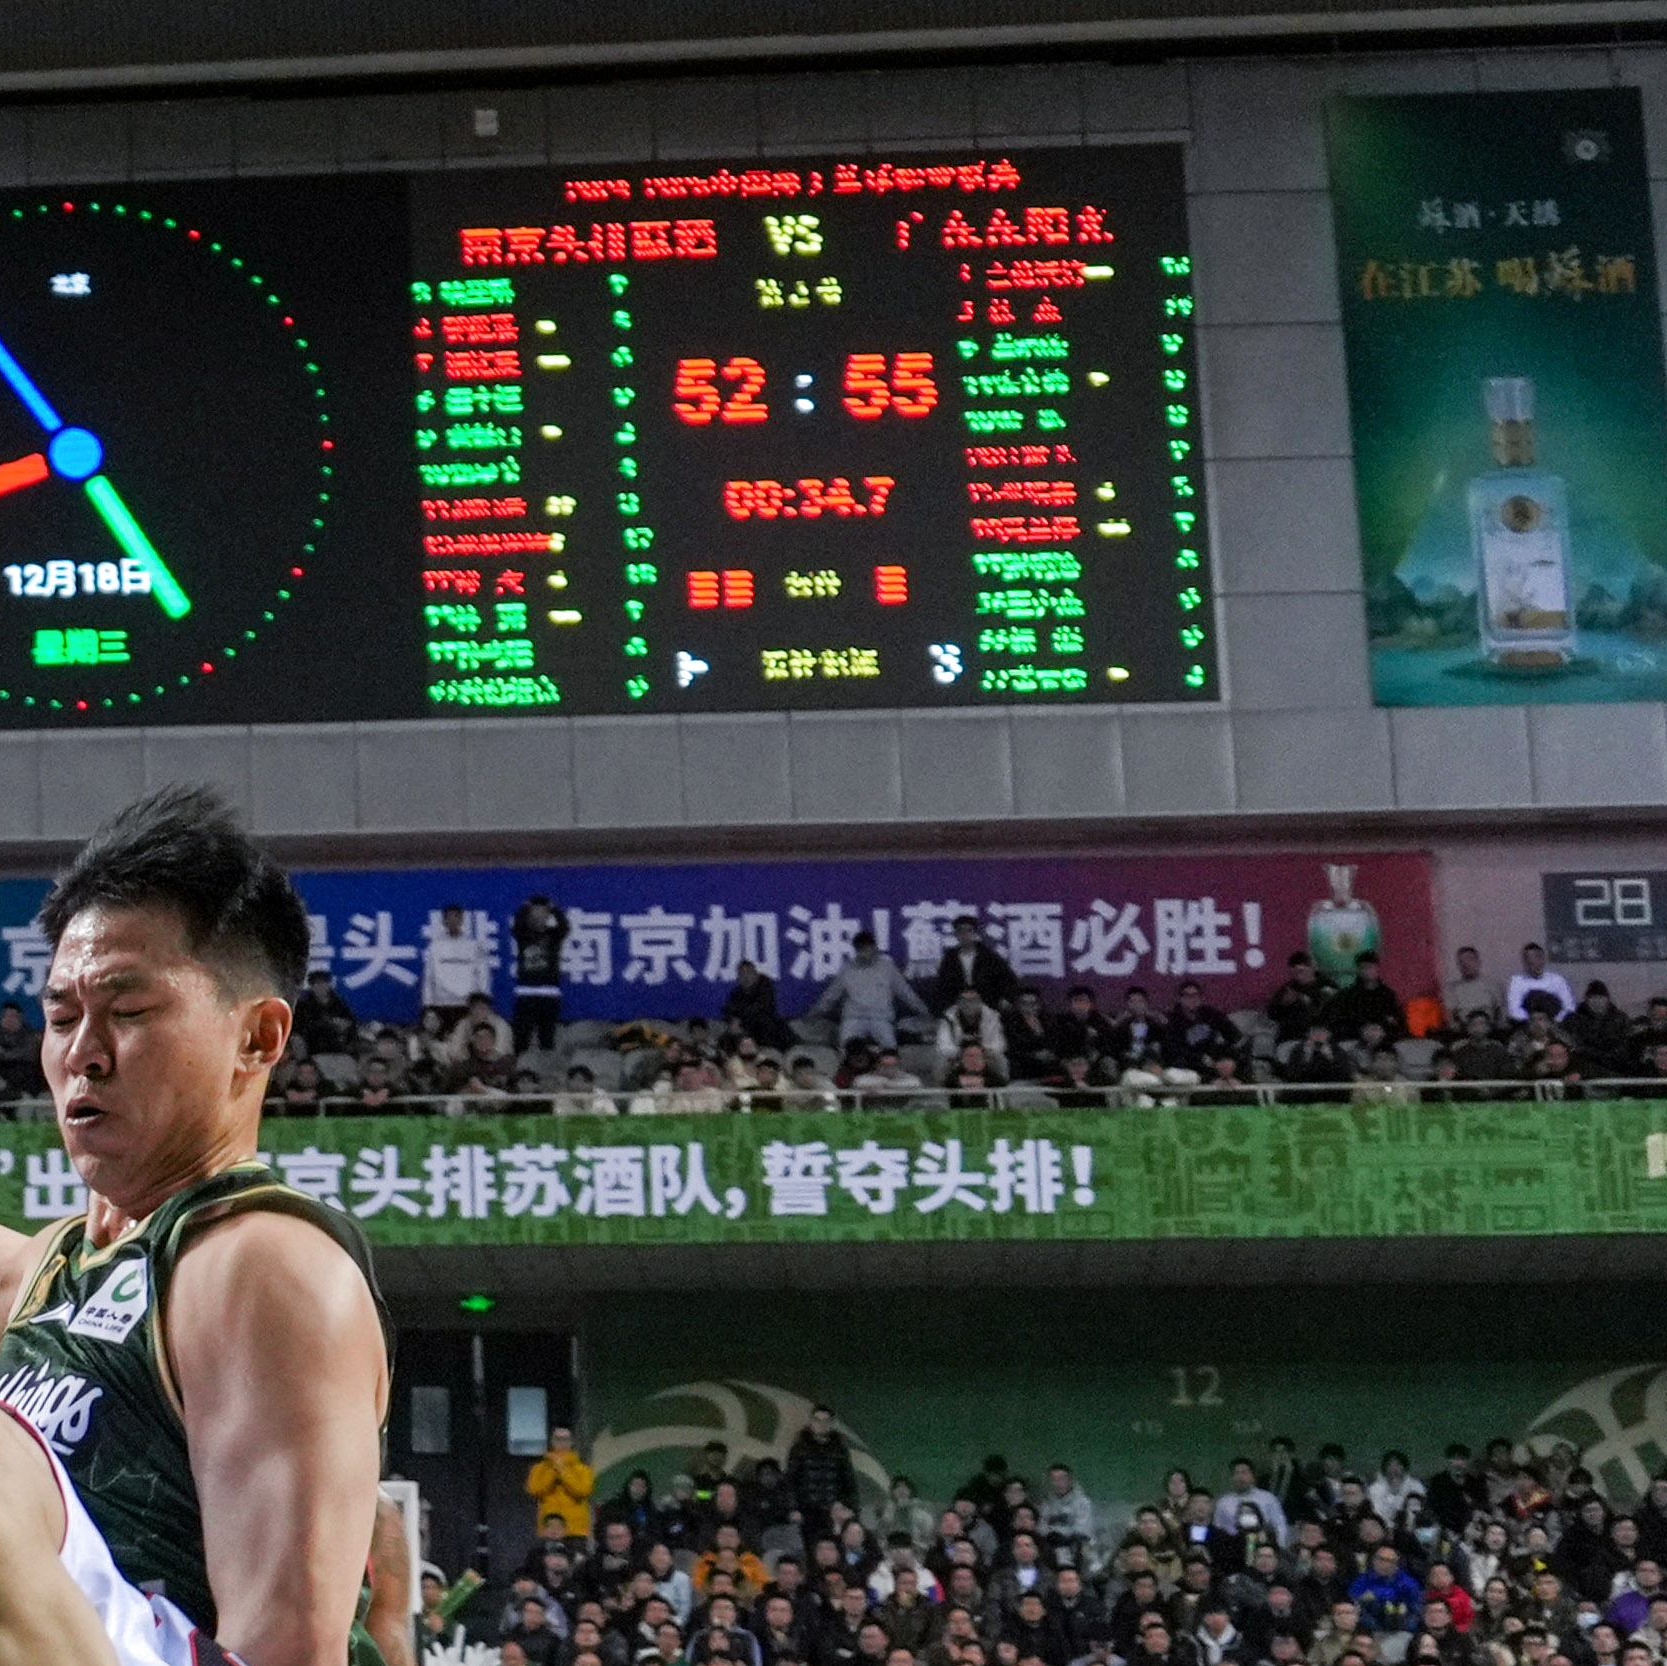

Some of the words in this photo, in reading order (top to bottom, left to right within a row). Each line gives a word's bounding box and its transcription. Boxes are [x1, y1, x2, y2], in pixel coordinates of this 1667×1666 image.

[762, 214, 823, 256] VS
[671, 356, 770, 424] 52
[842, 351, 940, 420] 55
[3, 556, 153, 598] 12月18日
[1573, 878, 1653, 927] 28
[257, 1138, 1097, 1218] 京头排苏酒队，誓夺头排！
[1169, 1366, 1224, 1406] 12
